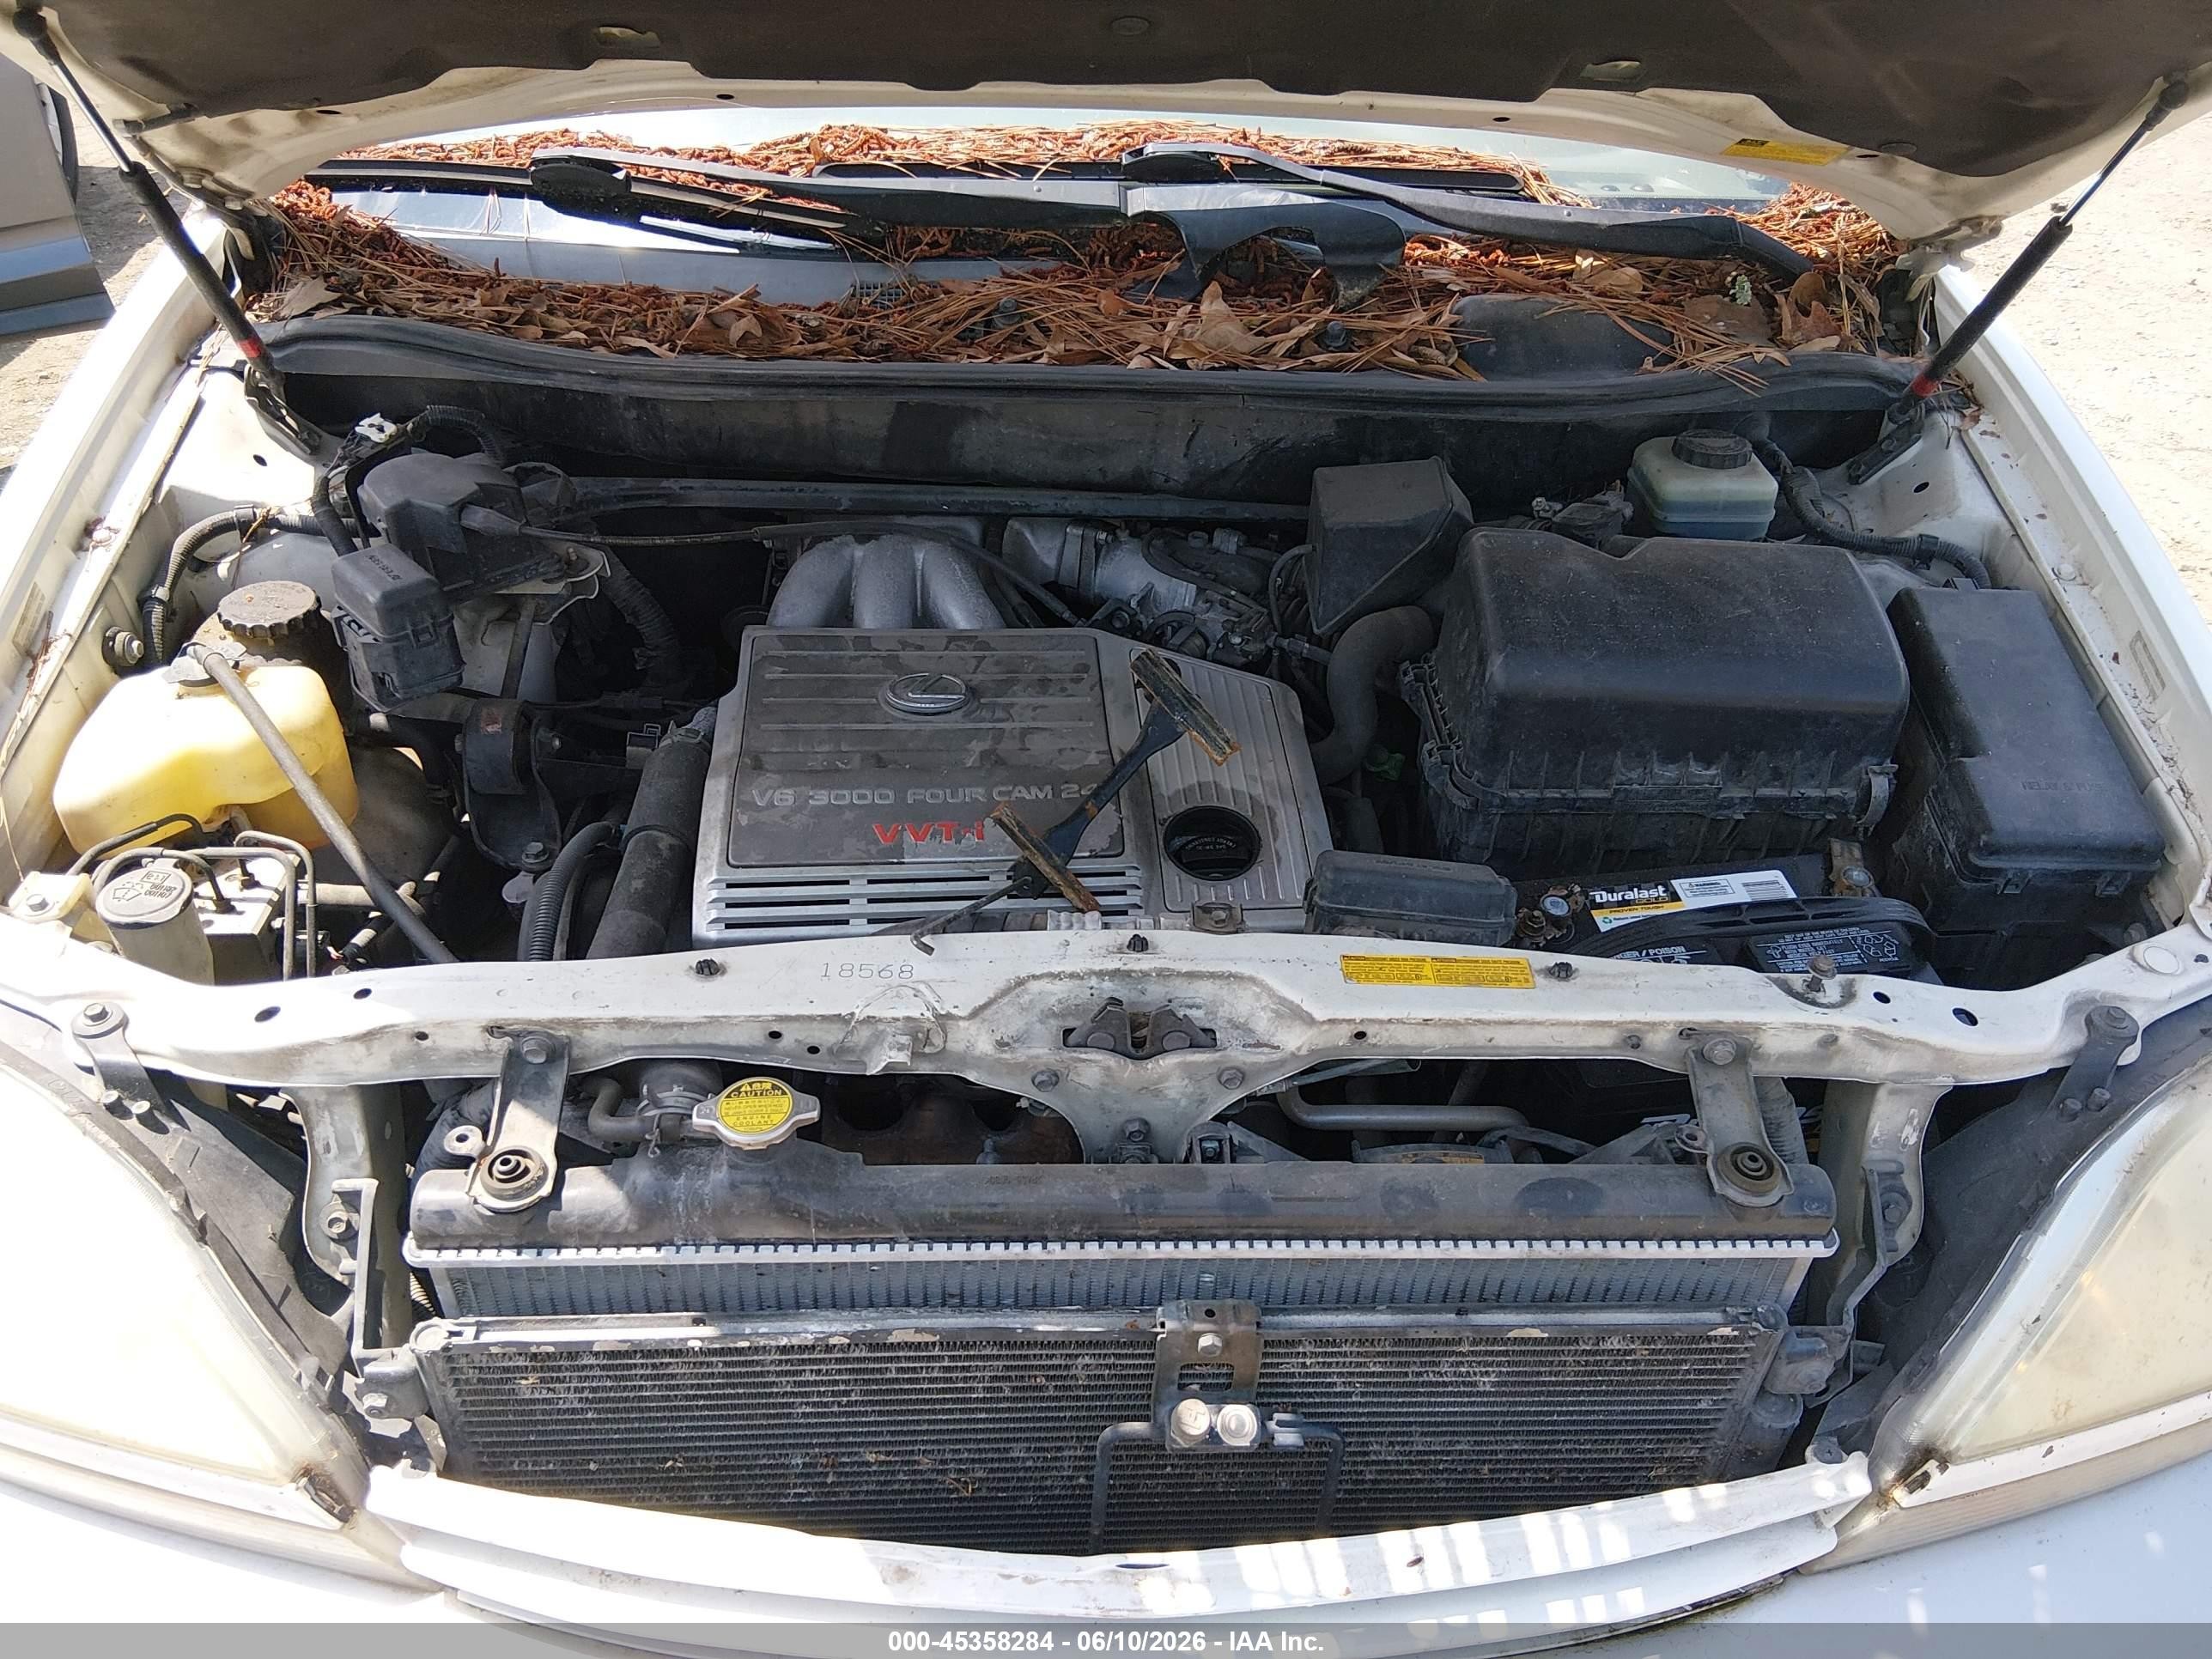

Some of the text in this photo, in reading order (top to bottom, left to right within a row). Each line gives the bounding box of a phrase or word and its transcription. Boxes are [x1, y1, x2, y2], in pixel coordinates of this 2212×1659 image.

[752, 788, 795, 805] V6
[809, 787, 895, 805] 3000
[908, 786, 986, 804] FOUR
[993, 784, 1053, 800] CAM
[1589, 884, 1668, 902] Duralast
[1649, 945, 1686, 956] POISON
[821, 963, 914, 979] 18568
[731, 1089, 782, 1098] CAUTION
